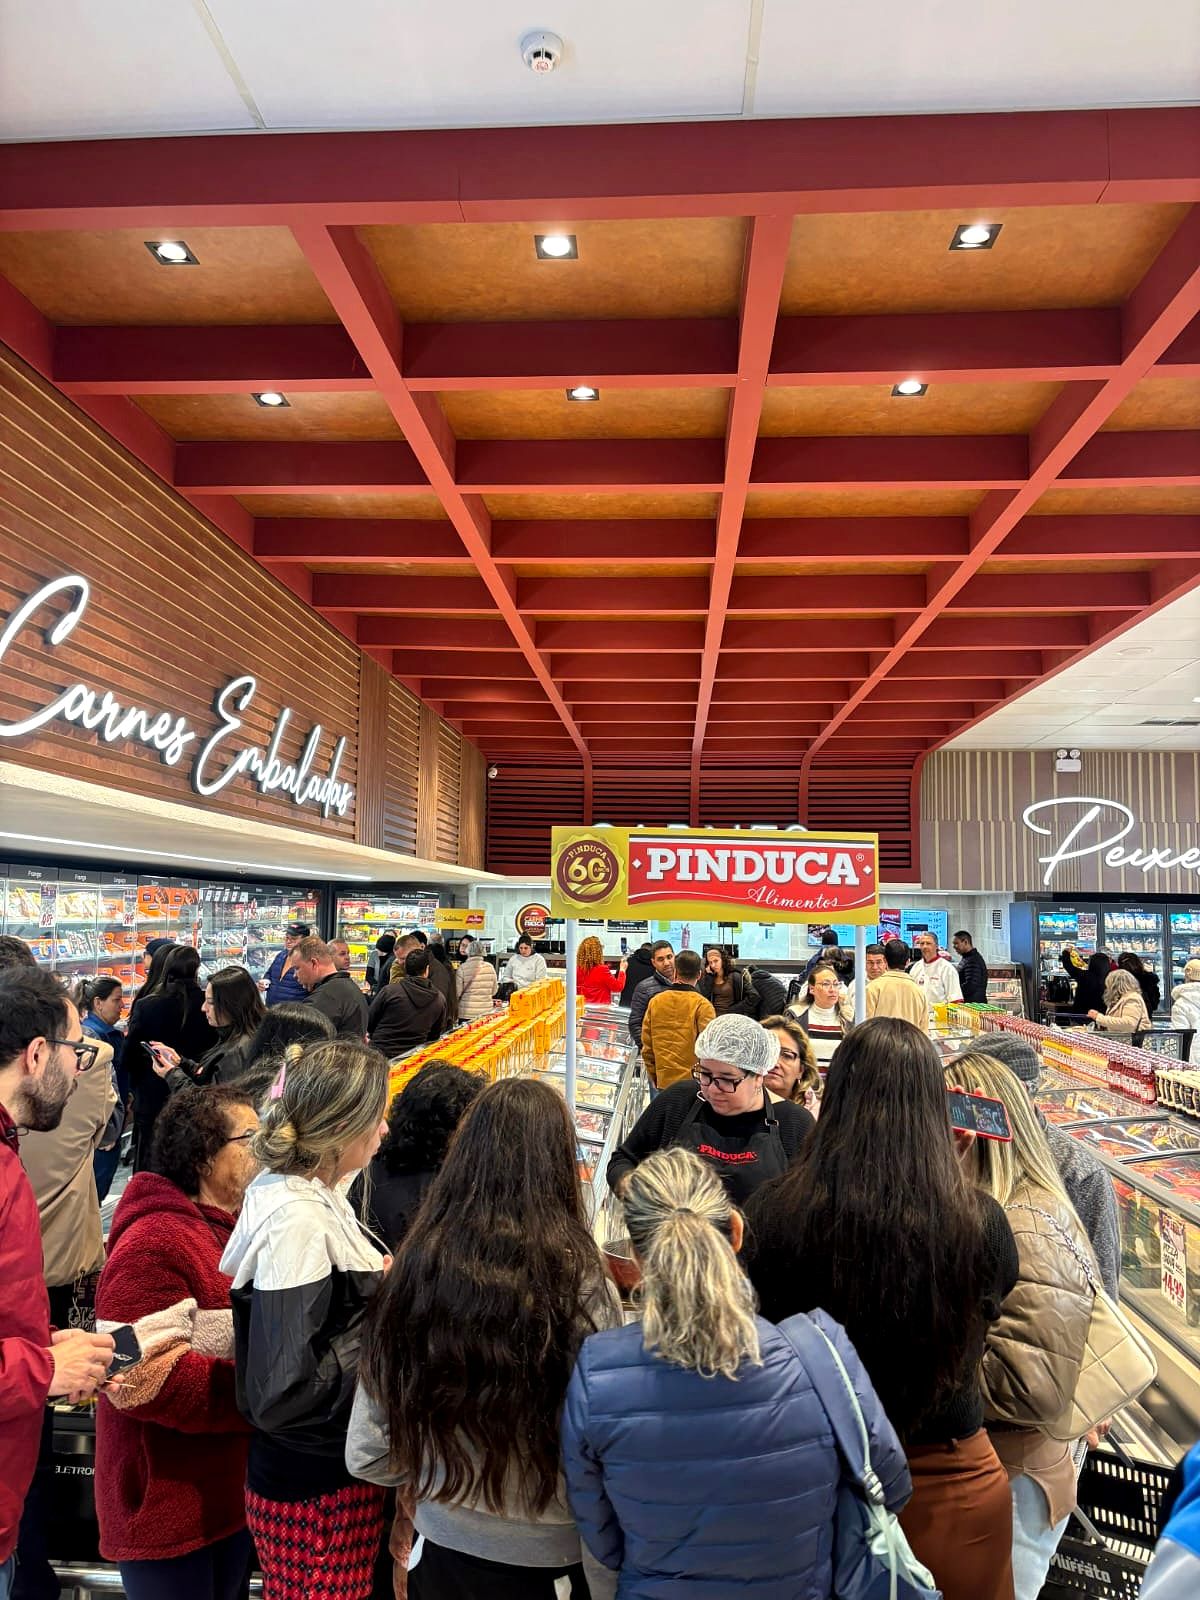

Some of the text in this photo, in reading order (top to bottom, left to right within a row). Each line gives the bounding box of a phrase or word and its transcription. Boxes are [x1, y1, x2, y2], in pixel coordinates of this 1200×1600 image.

[0, 575, 194, 765] Carnes
[568, 845, 608, 859] PINDUCA
[646, 848, 860, 885] PINDUCA
[747, 885, 839, 910] Alimentos
[699, 1144, 756, 1160] PINDUCA
